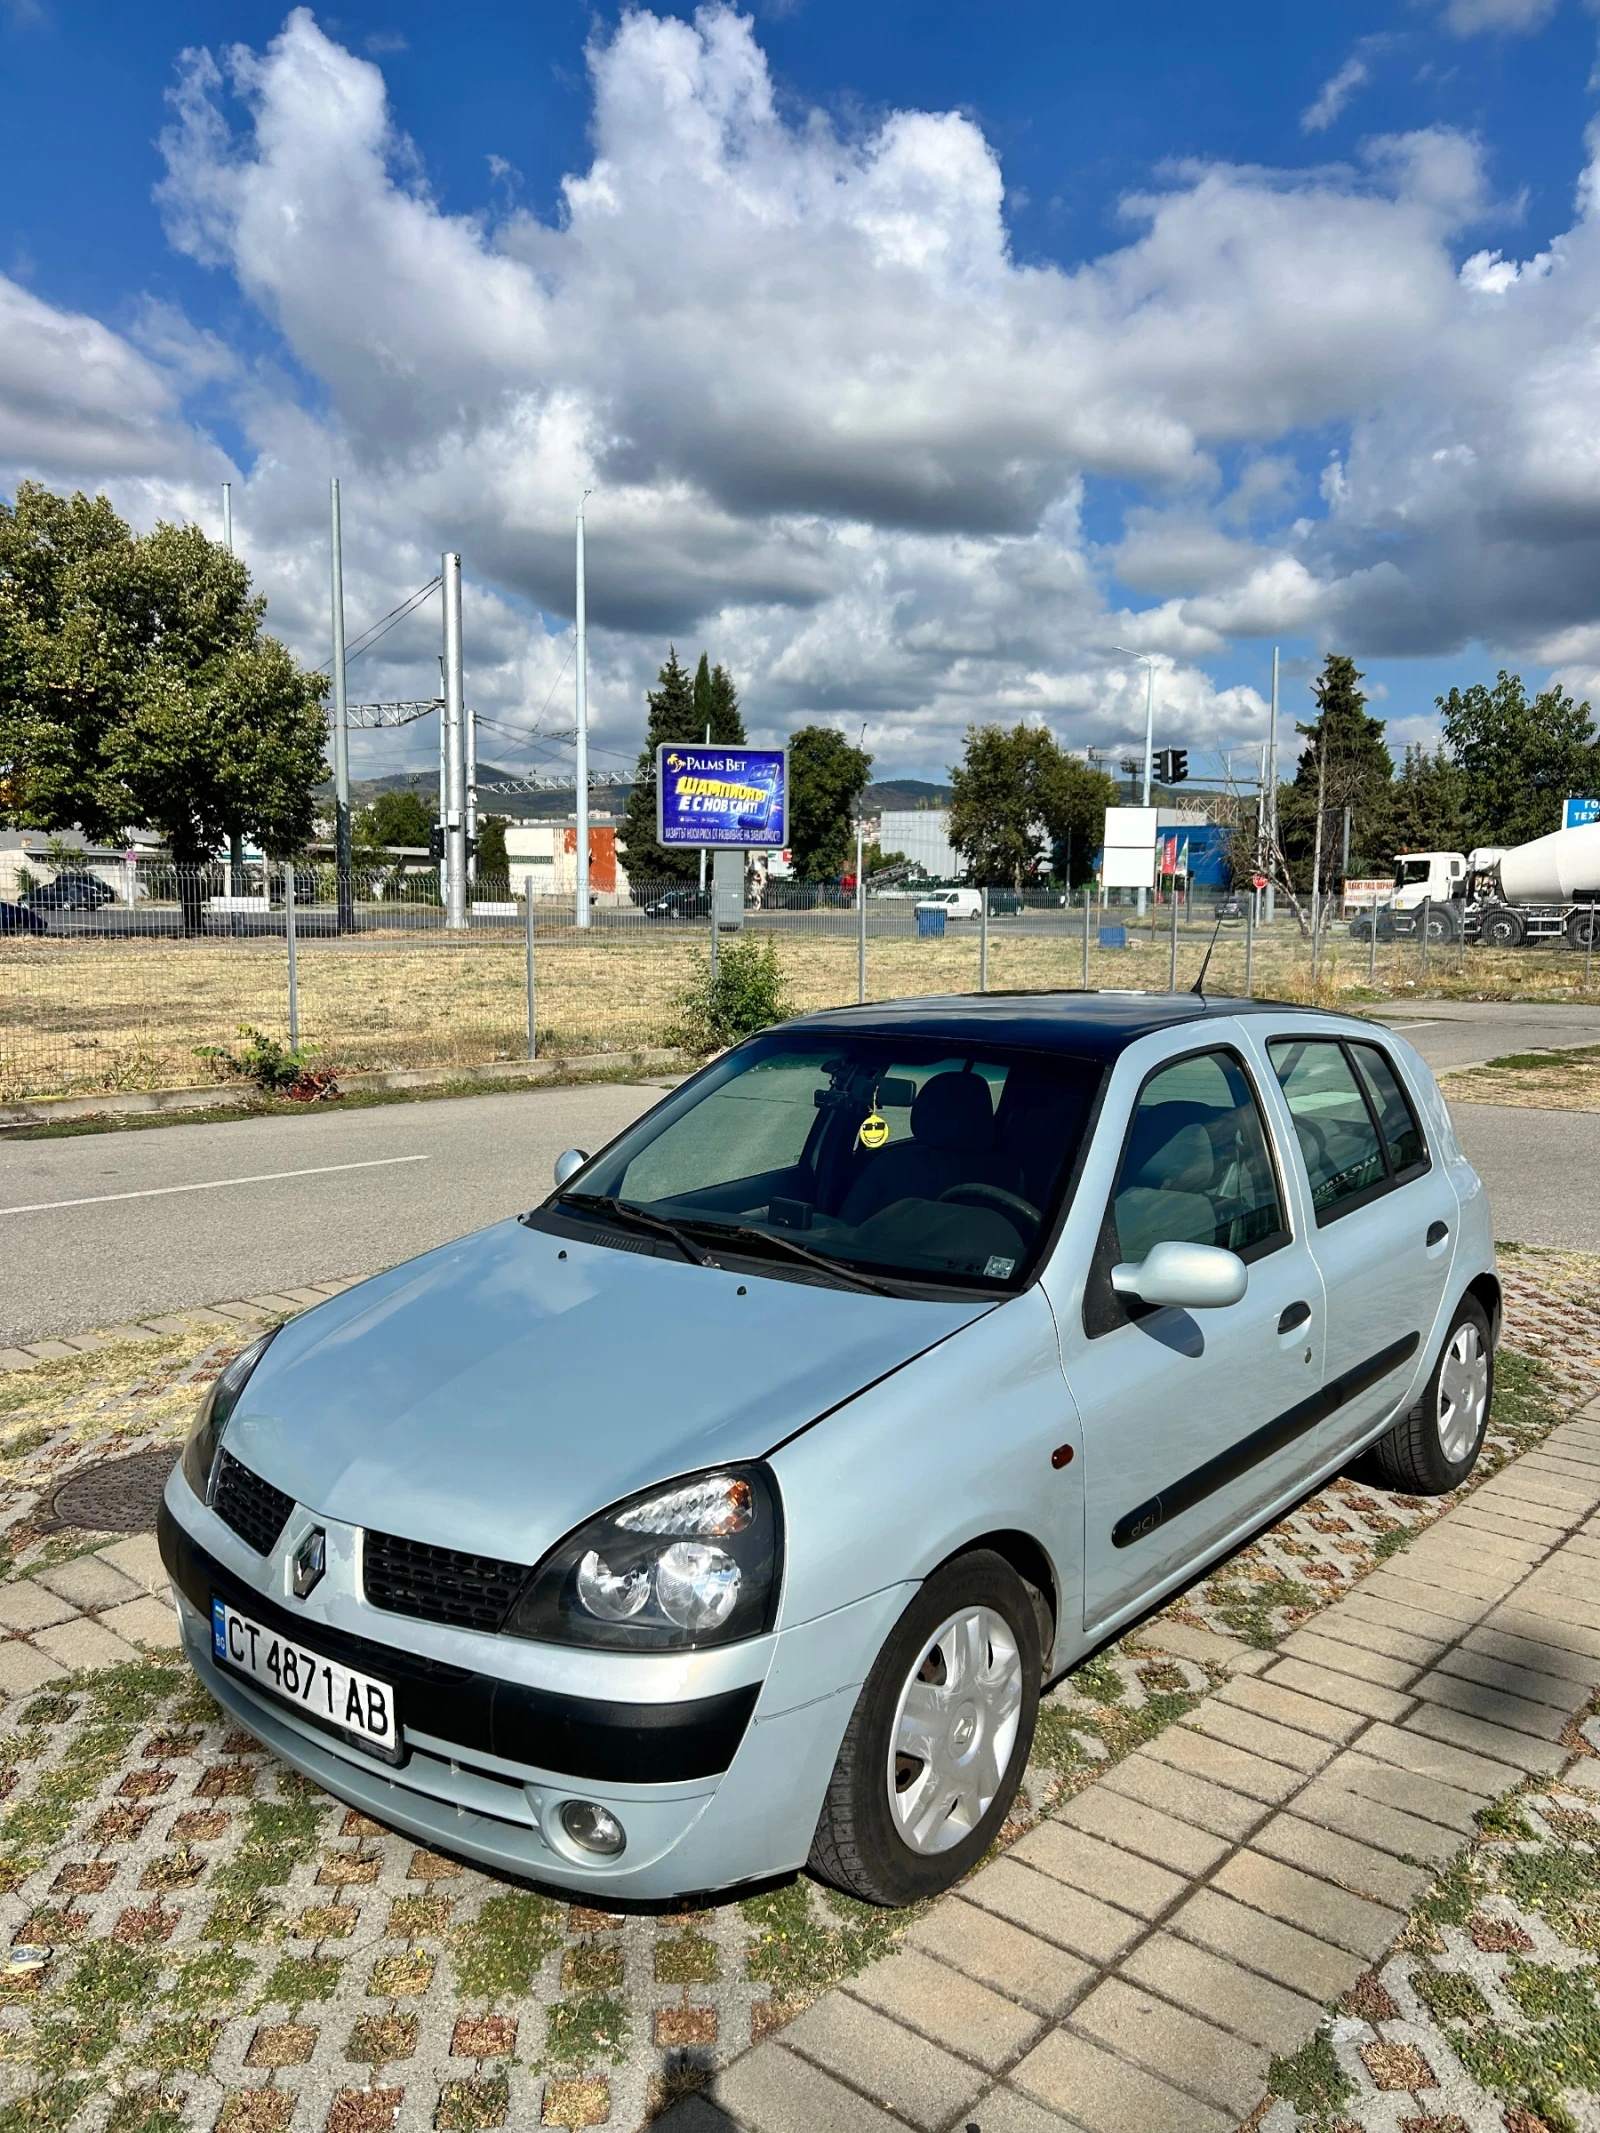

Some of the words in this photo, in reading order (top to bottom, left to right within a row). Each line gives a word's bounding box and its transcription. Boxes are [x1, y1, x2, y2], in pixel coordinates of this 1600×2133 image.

[686, 756, 724, 771] PALMS
[725, 758, 748, 772] BET
[679, 796, 691, 811] Е
[692, 797, 702, 811] С
[703, 798, 728, 813] НОВ
[215, 1633, 226, 1650] BG
[228, 1616, 261, 1671] CT
[266, 1640, 334, 1714] 4871
[345, 1677, 388, 1736] AB
